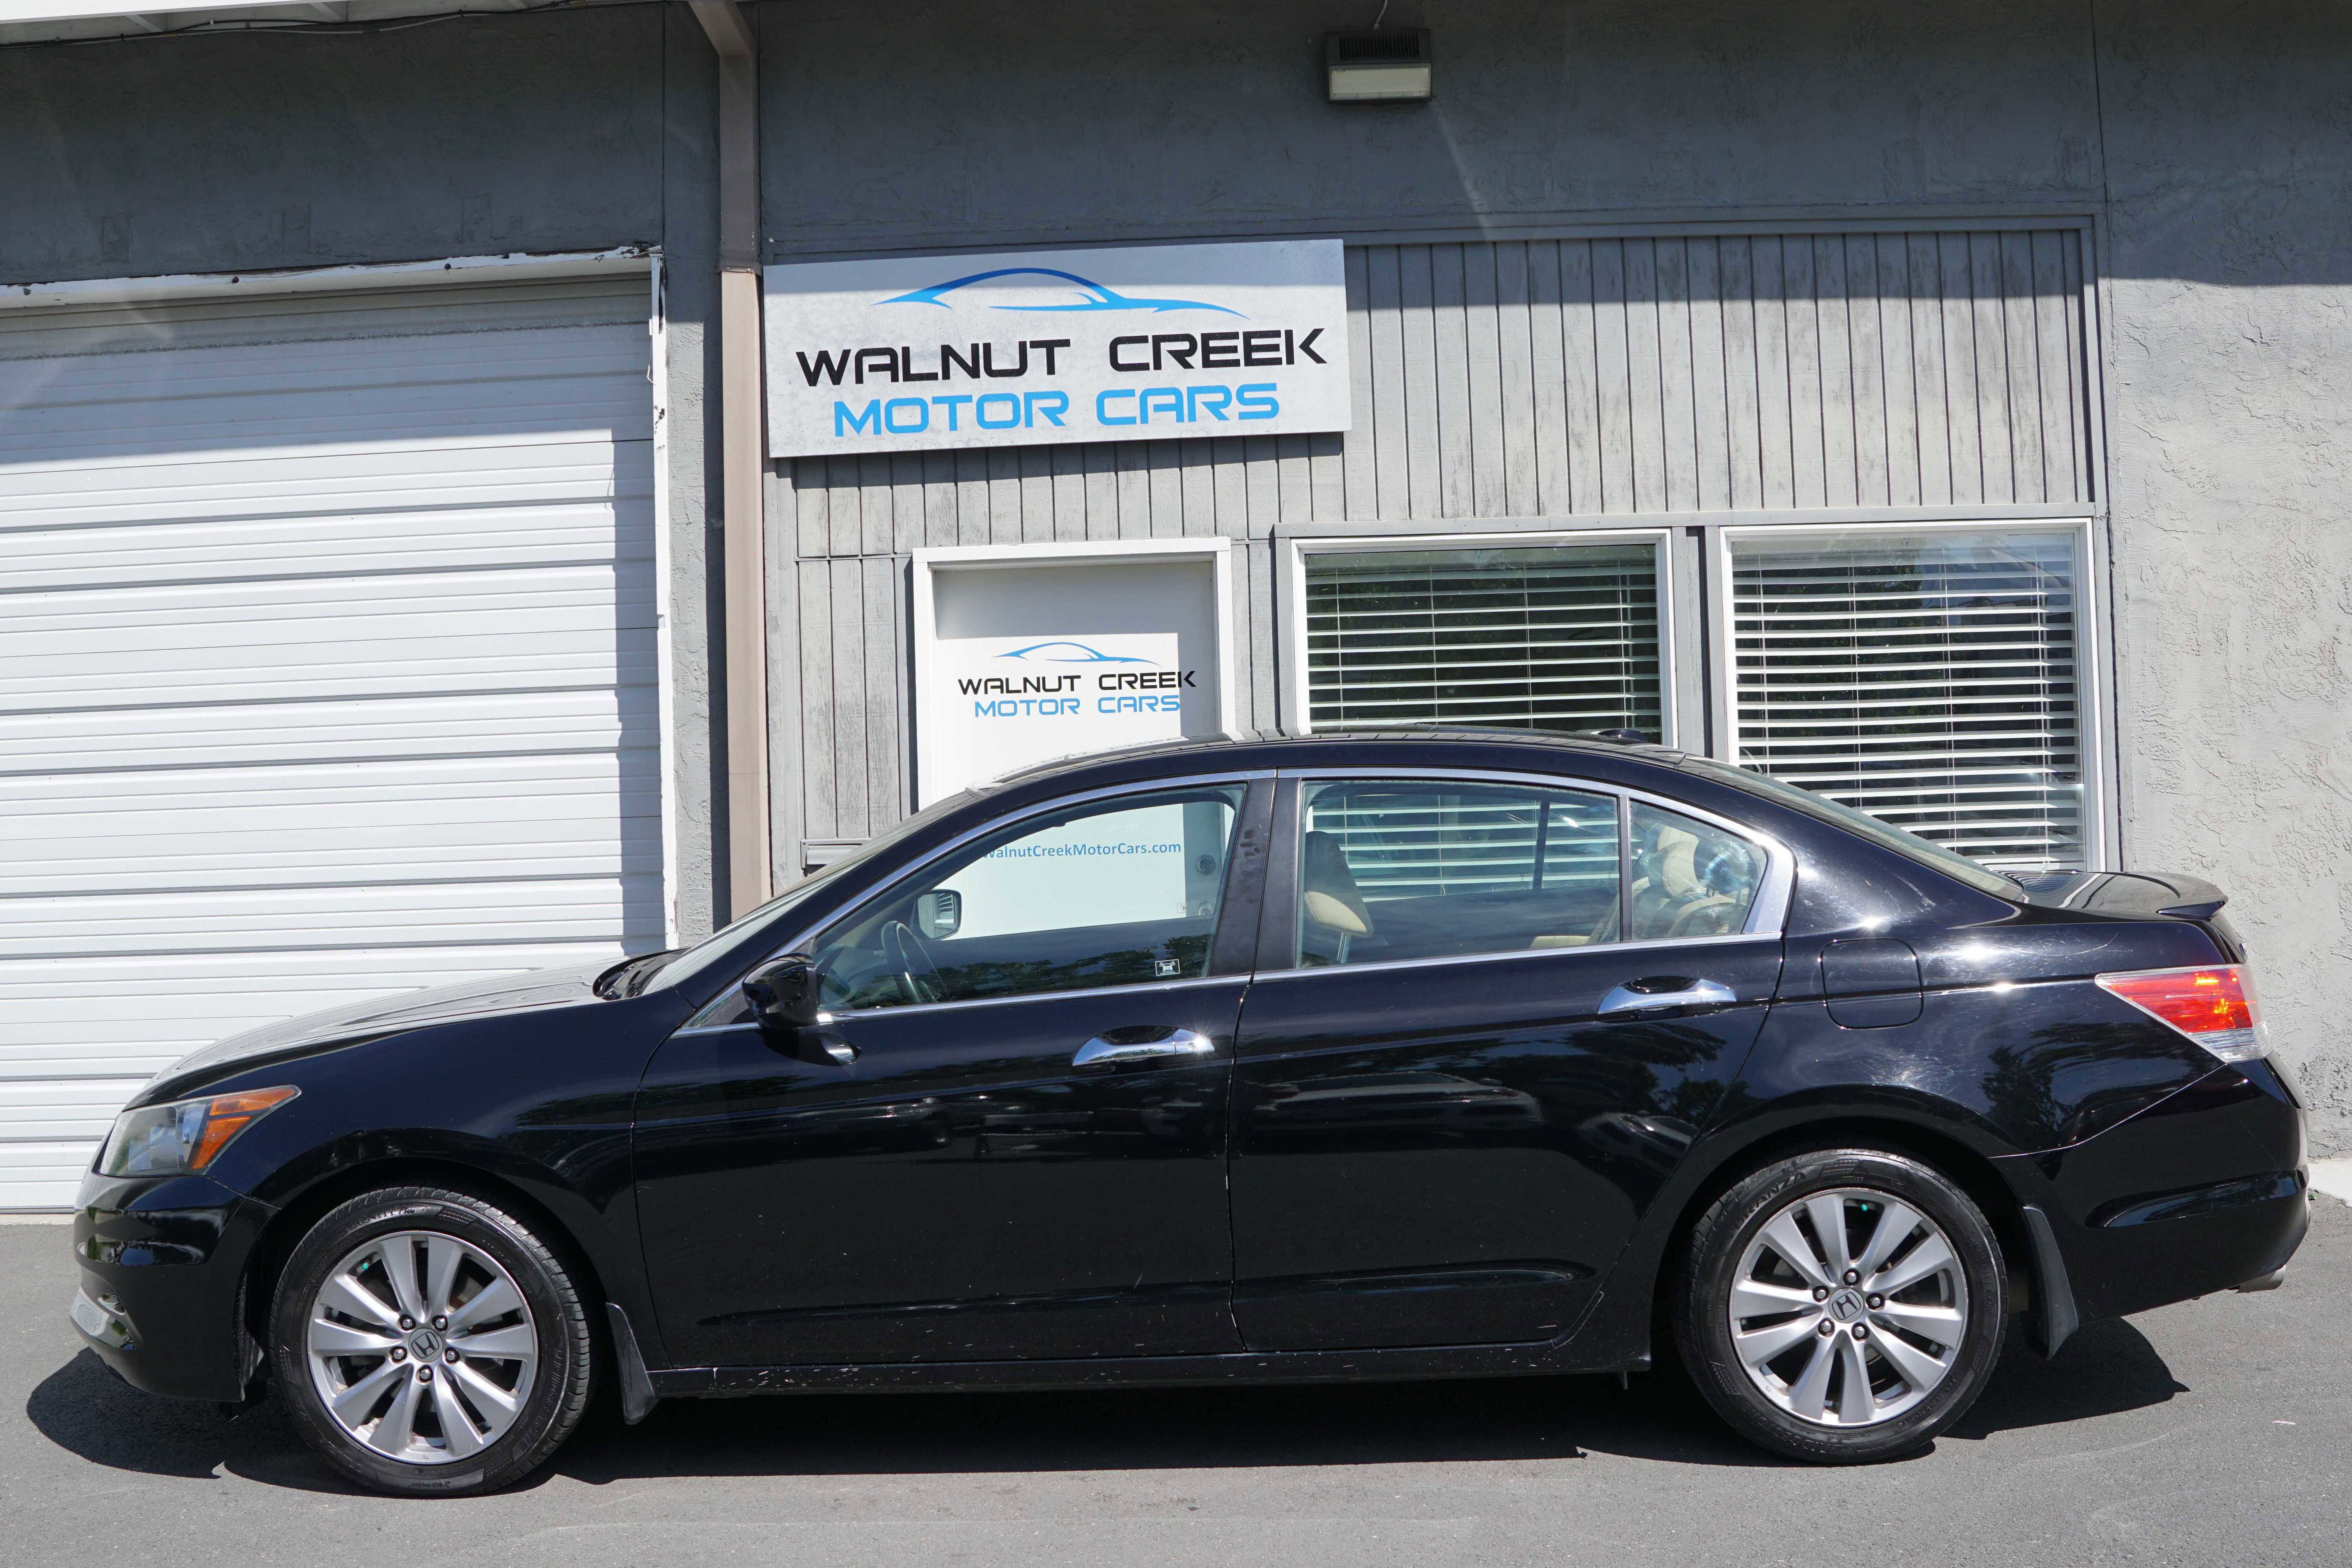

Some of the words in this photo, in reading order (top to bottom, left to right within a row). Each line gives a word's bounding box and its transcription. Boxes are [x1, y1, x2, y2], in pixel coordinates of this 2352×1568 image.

[796, 339, 1071, 387] WALNUT
[1109, 328, 1327, 372] CREEK
[833, 390, 1070, 438] MOTOR
[1096, 382, 1280, 426] CARS
[958, 675, 1081, 695] WALNUT
[1098, 670, 1197, 690] CREEK
[975, 698, 1080, 718] MOTOR
[1098, 695, 1181, 713] CARS
